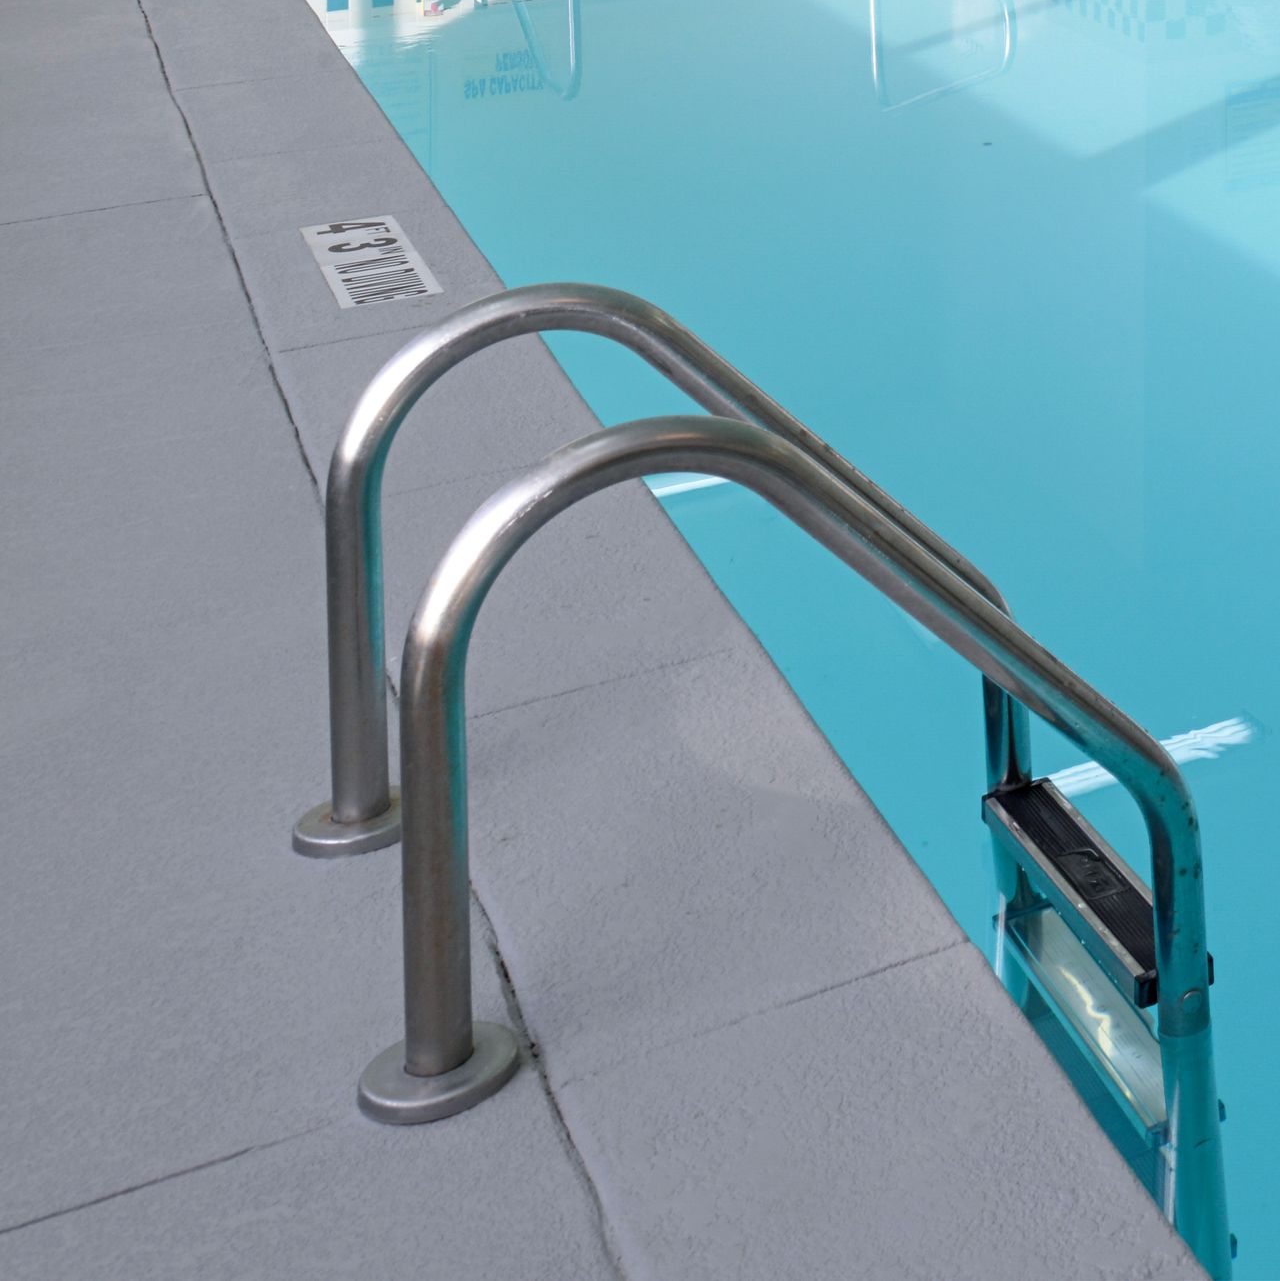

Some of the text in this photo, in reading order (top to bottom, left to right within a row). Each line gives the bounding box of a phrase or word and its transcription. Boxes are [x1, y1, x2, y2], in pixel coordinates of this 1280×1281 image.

[317, 222, 386, 235] 4
[328, 237, 398, 253] 3
[334, 254, 428, 305] NO DIVING
